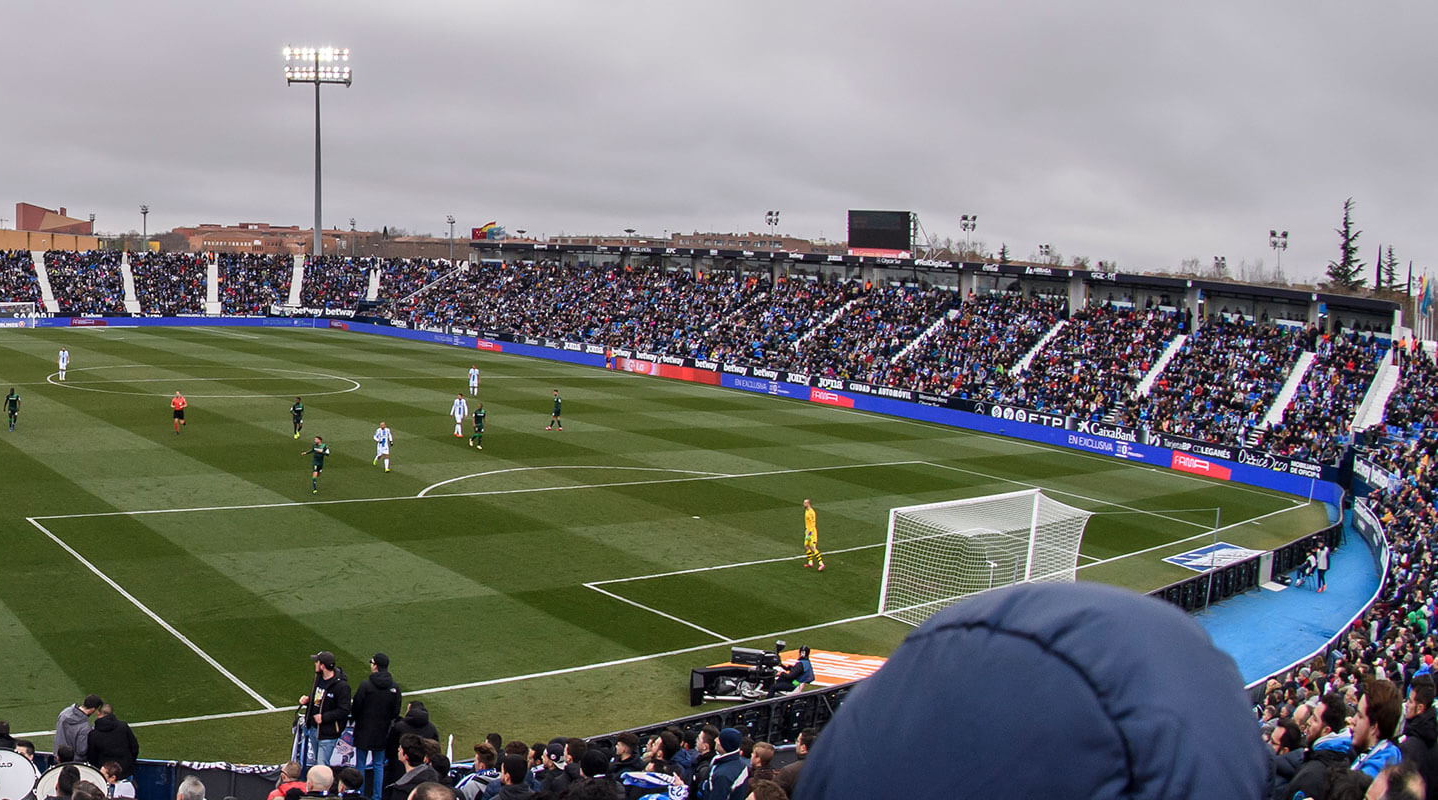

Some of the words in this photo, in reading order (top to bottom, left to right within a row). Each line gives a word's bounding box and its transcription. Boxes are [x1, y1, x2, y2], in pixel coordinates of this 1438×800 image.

[325, 307, 356, 319] betway
[636, 350, 658, 363] betway
[662, 351, 685, 367] betway
[694, 358, 719, 372] betway
[723, 362, 748, 376] betway
[753, 366, 779, 381] betway
[741, 379, 768, 391] EXCLUSIVA
[849, 382, 871, 394] CIUDAD
[878, 387, 912, 400] AUTOMÓVIL
[1028, 414, 1063, 428] FTP
[1090, 422, 1137, 443] CaixaBank
[1068, 434, 1078, 445] EN
[1079, 436, 1113, 452] EXCLUSIVA
[1289, 467, 1299, 475] DE
[1290, 460, 1322, 473] MOBILIARIO
